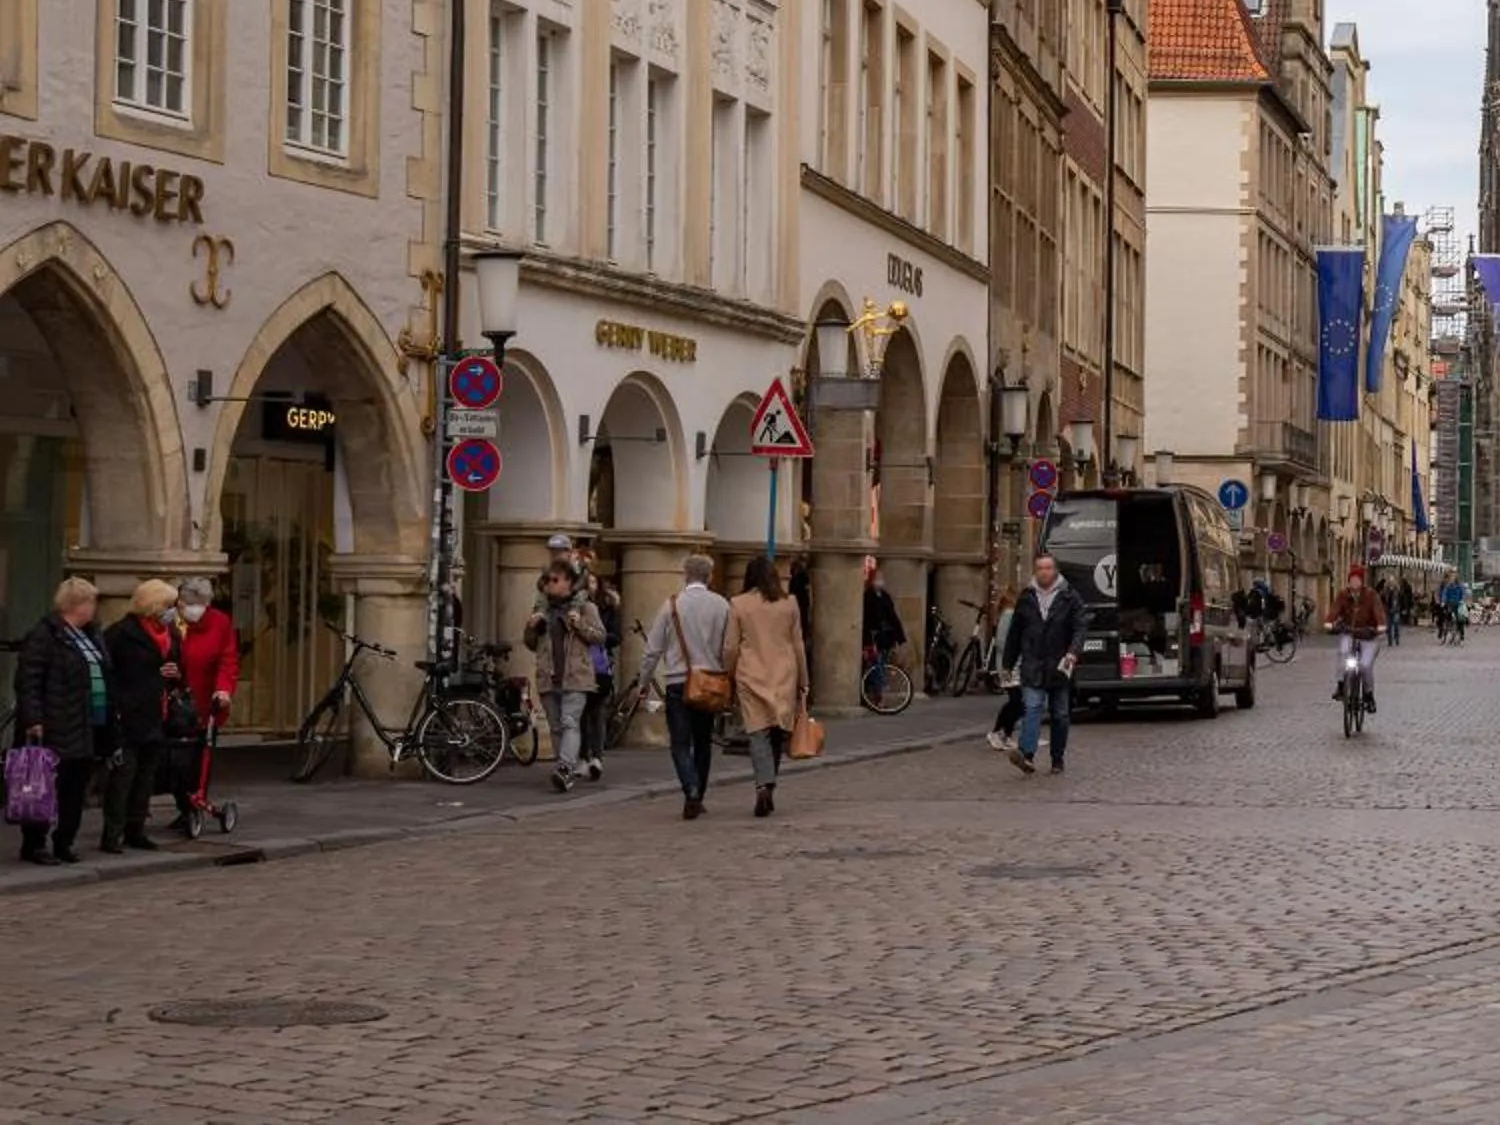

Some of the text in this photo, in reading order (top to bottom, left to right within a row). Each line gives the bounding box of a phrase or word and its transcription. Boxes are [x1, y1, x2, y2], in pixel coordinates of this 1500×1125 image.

[60, 147, 206, 225] KAISER
[595, 319, 697, 362] GERRY WEBER
